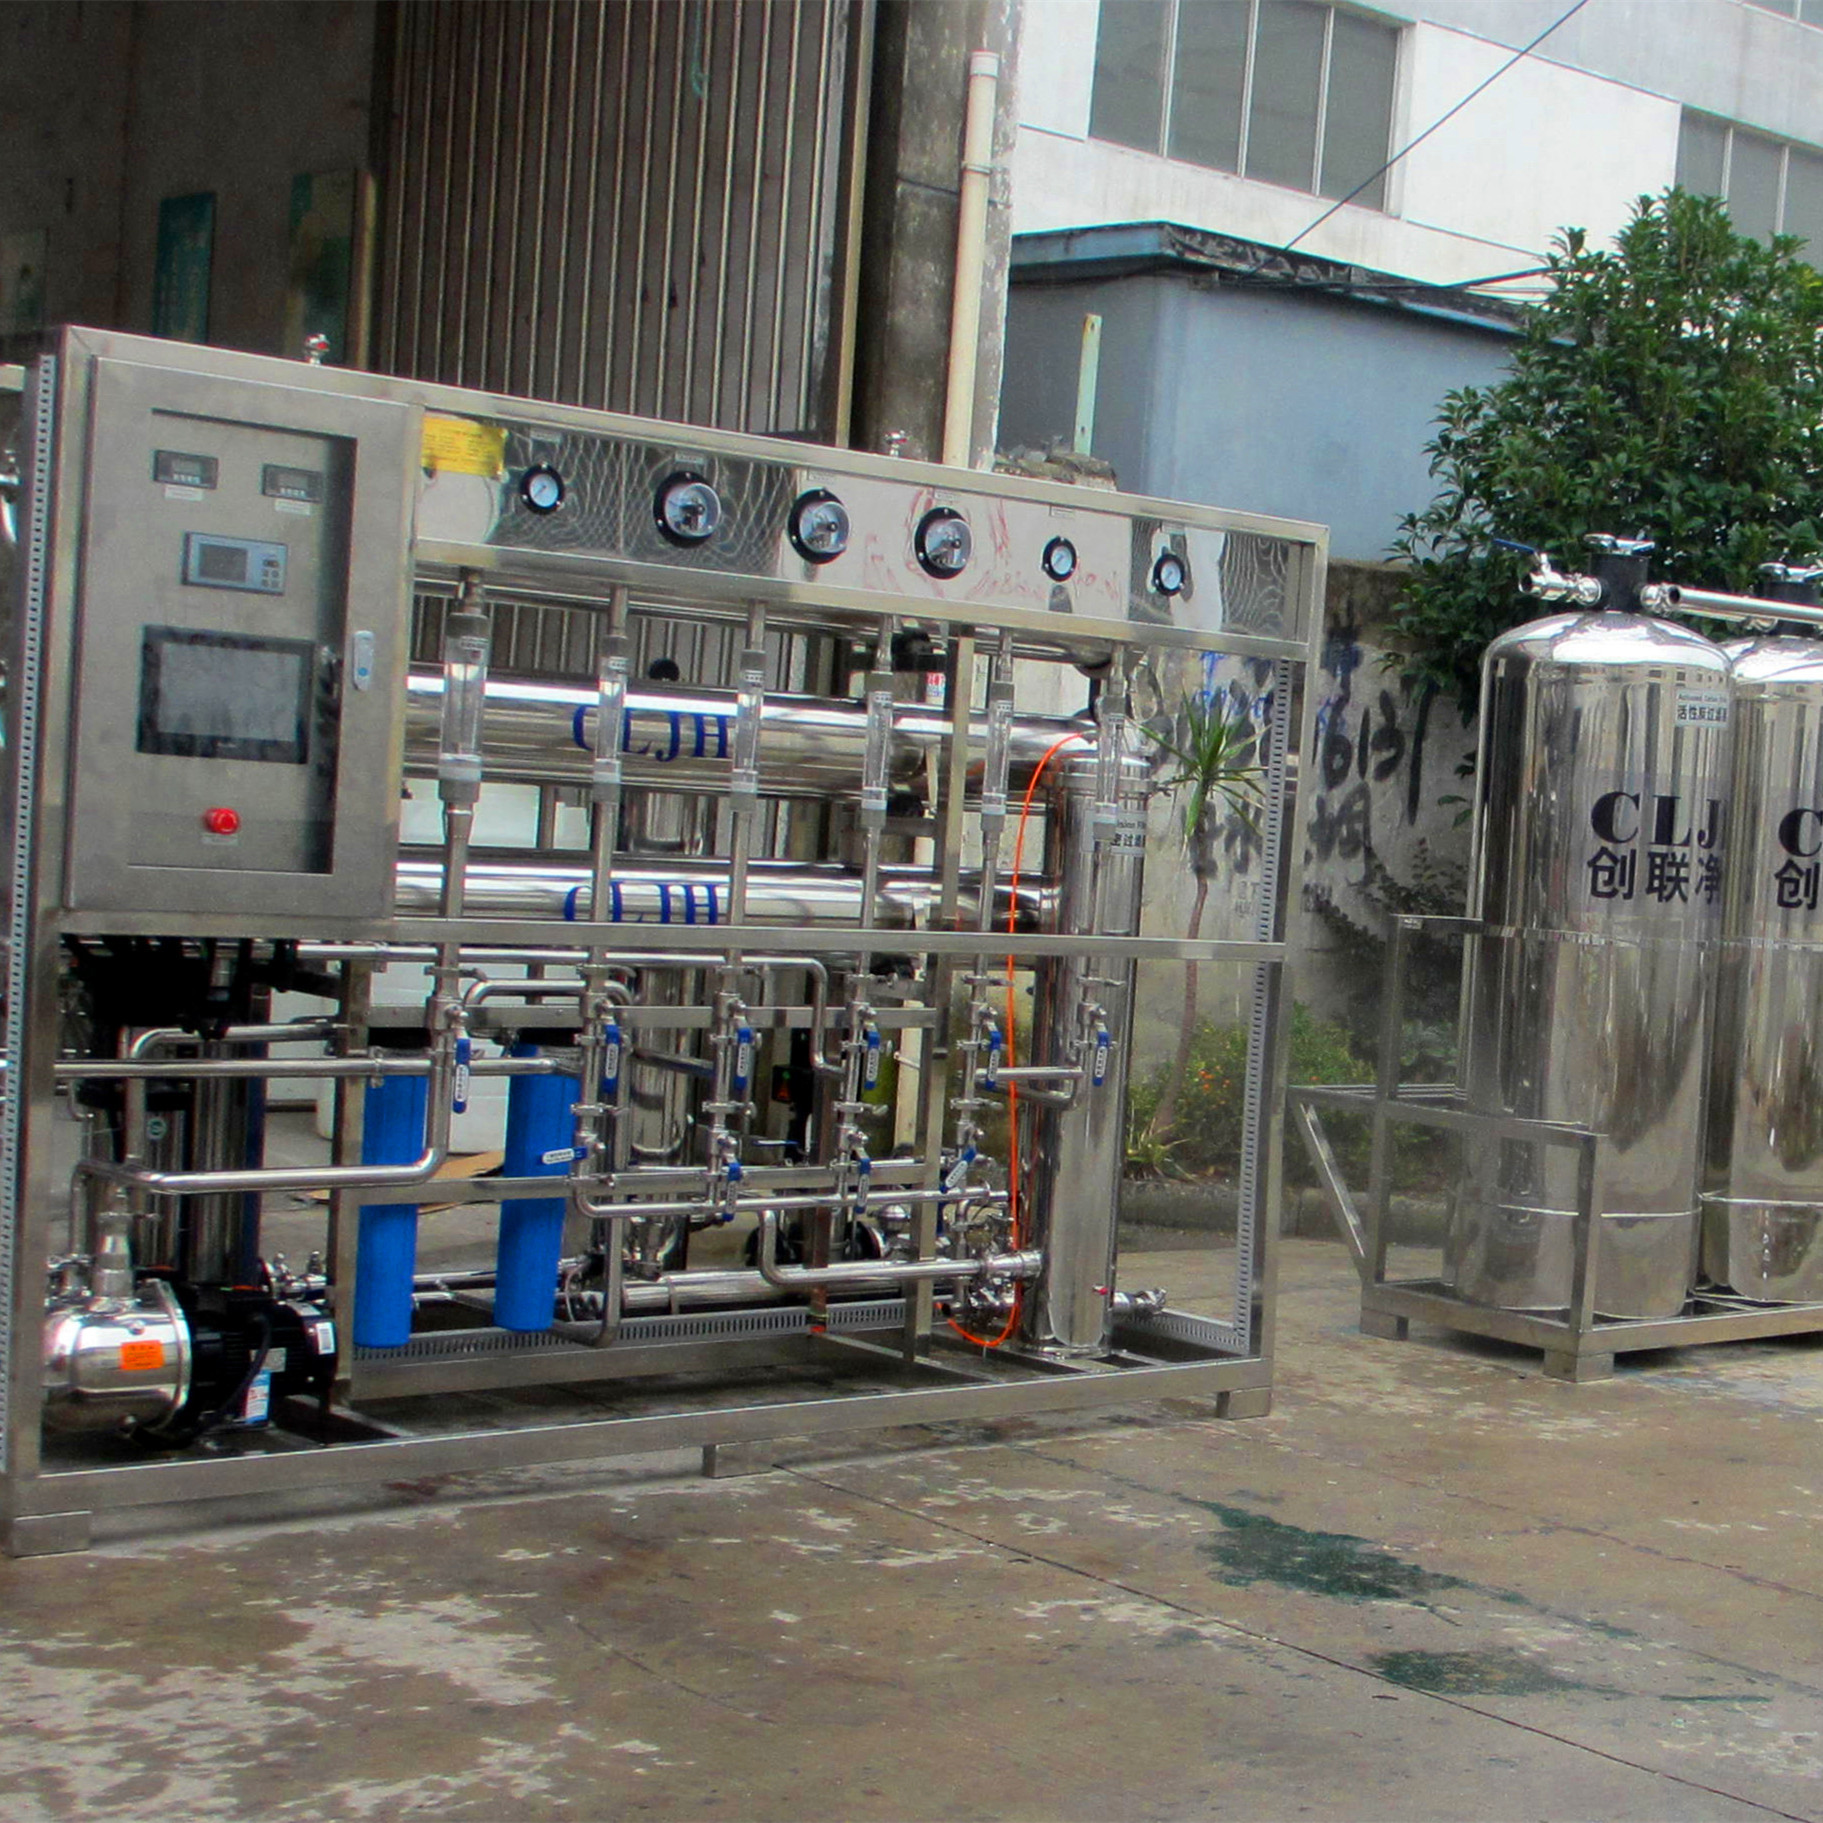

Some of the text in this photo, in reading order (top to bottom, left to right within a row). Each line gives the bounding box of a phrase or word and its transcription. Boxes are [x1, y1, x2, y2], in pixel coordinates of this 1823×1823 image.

[1591, 791, 1728, 849] CLJ
[1586, 846, 1722, 903] 创联净
[1773, 858, 1821, 911] 创
